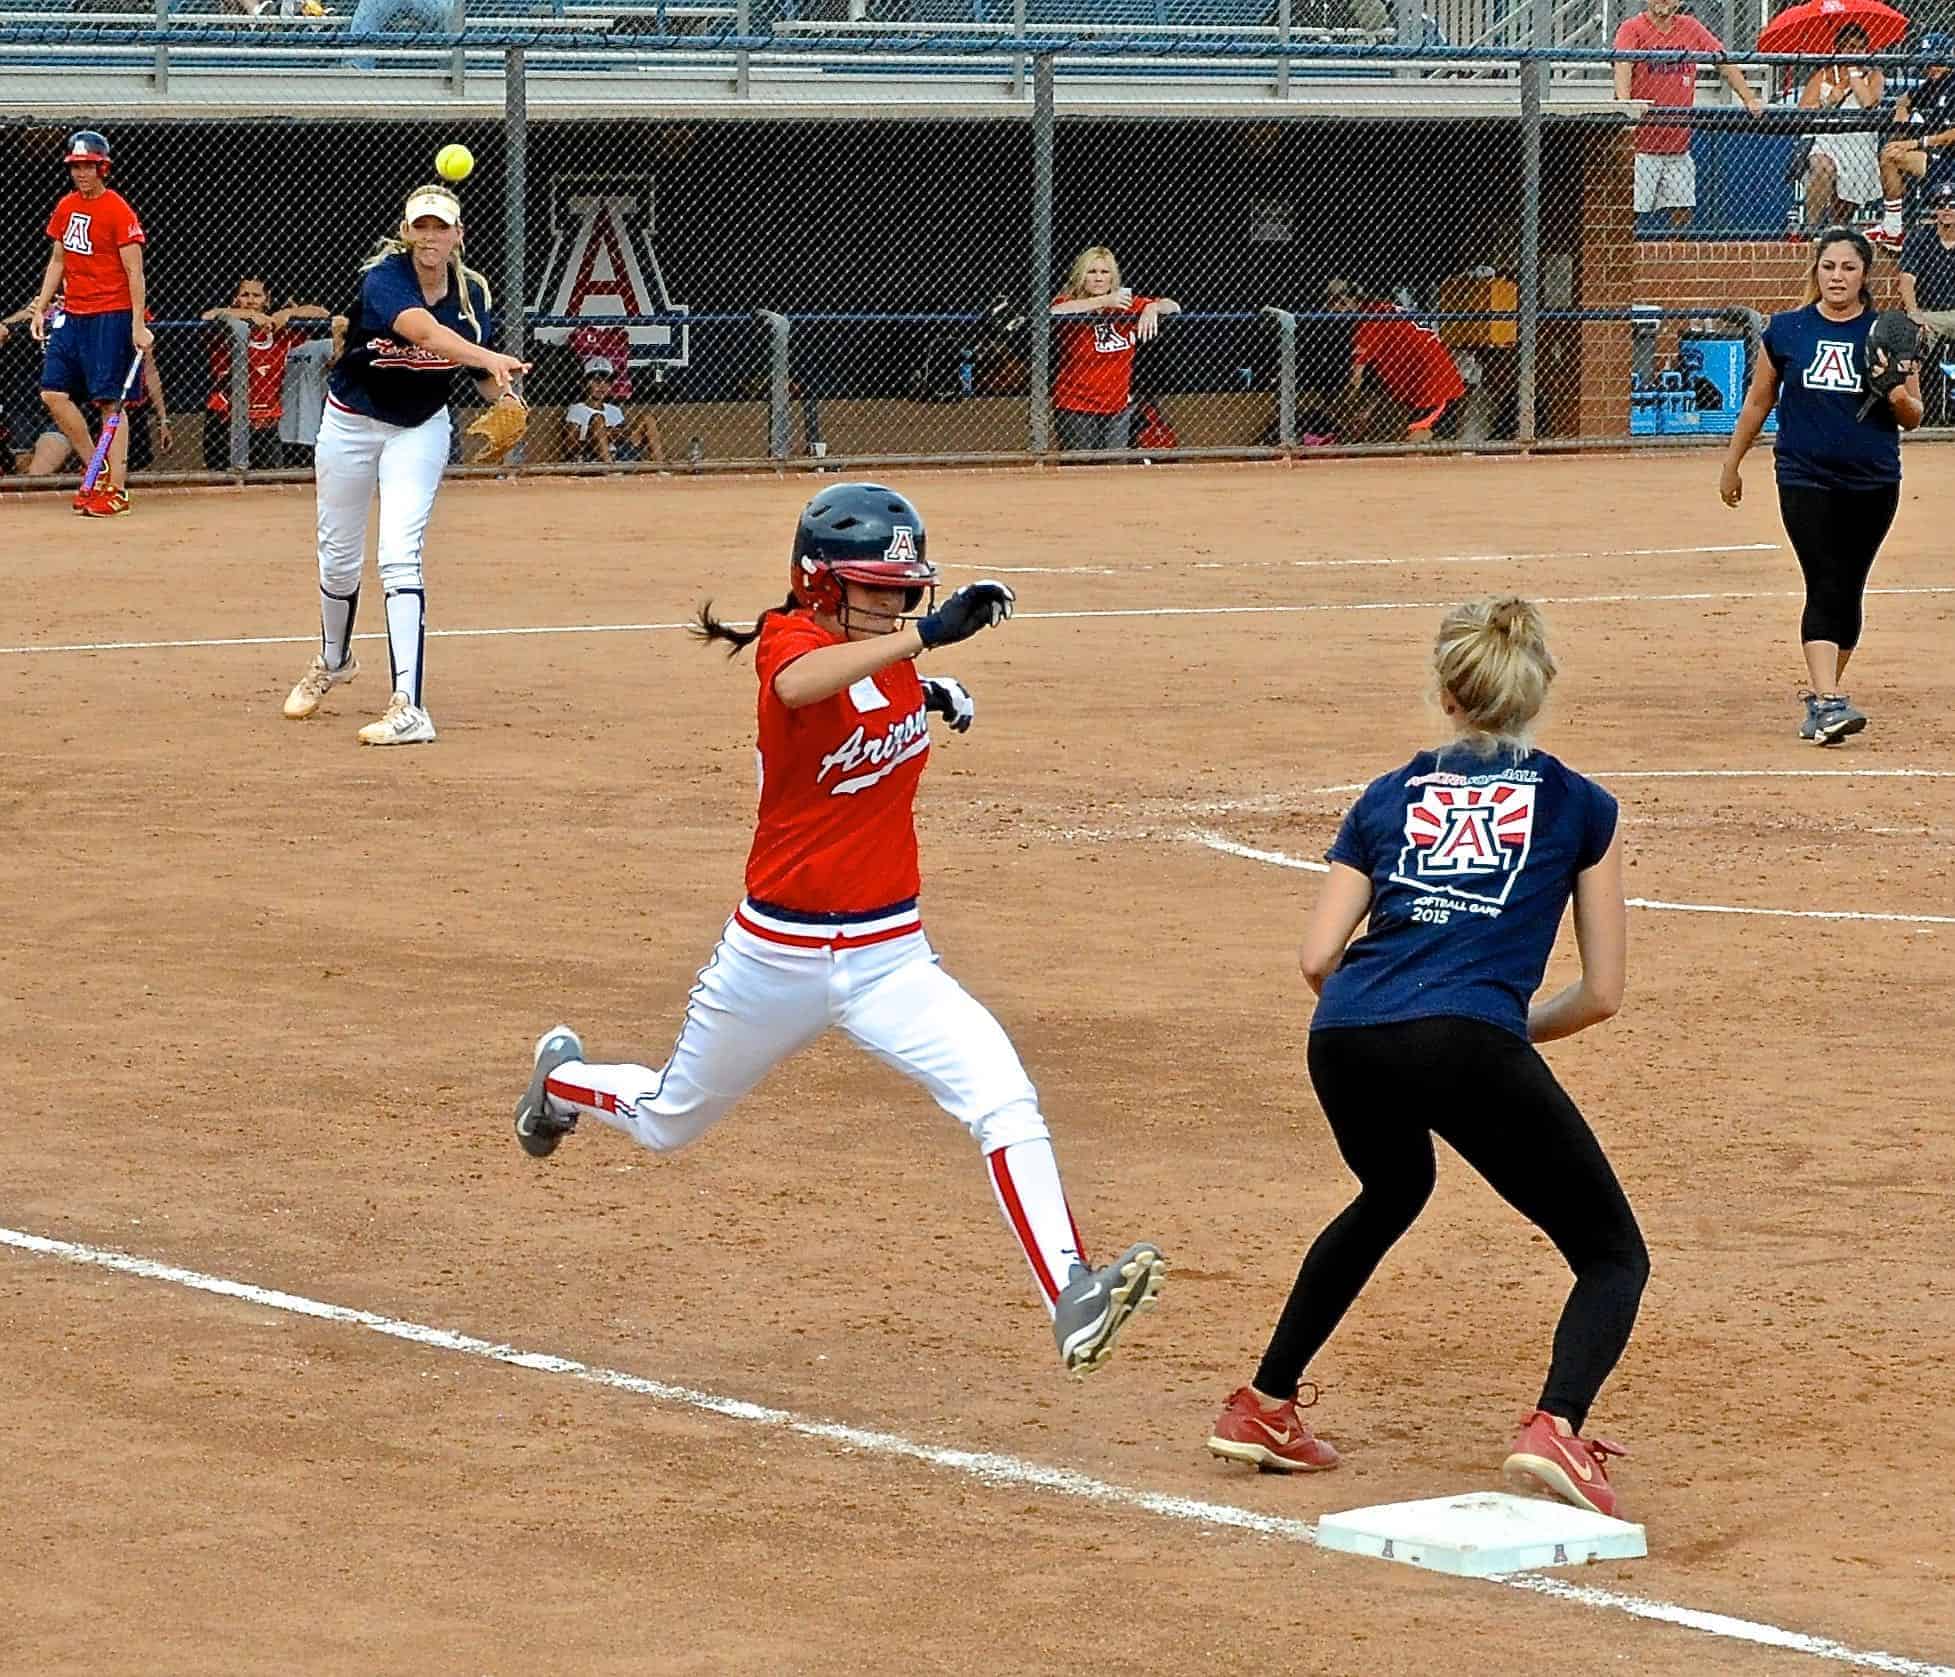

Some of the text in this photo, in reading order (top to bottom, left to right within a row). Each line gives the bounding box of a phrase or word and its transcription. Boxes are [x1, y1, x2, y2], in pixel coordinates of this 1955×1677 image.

[63, 211, 93, 255] A
[523, 174, 689, 367] A
[1803, 340, 1863, 392] A
[883, 525, 918, 562] A
[816, 704, 928, 784] Arizon
[1417, 804, 1511, 876] A
[1410, 906, 1451, 924] 2015
